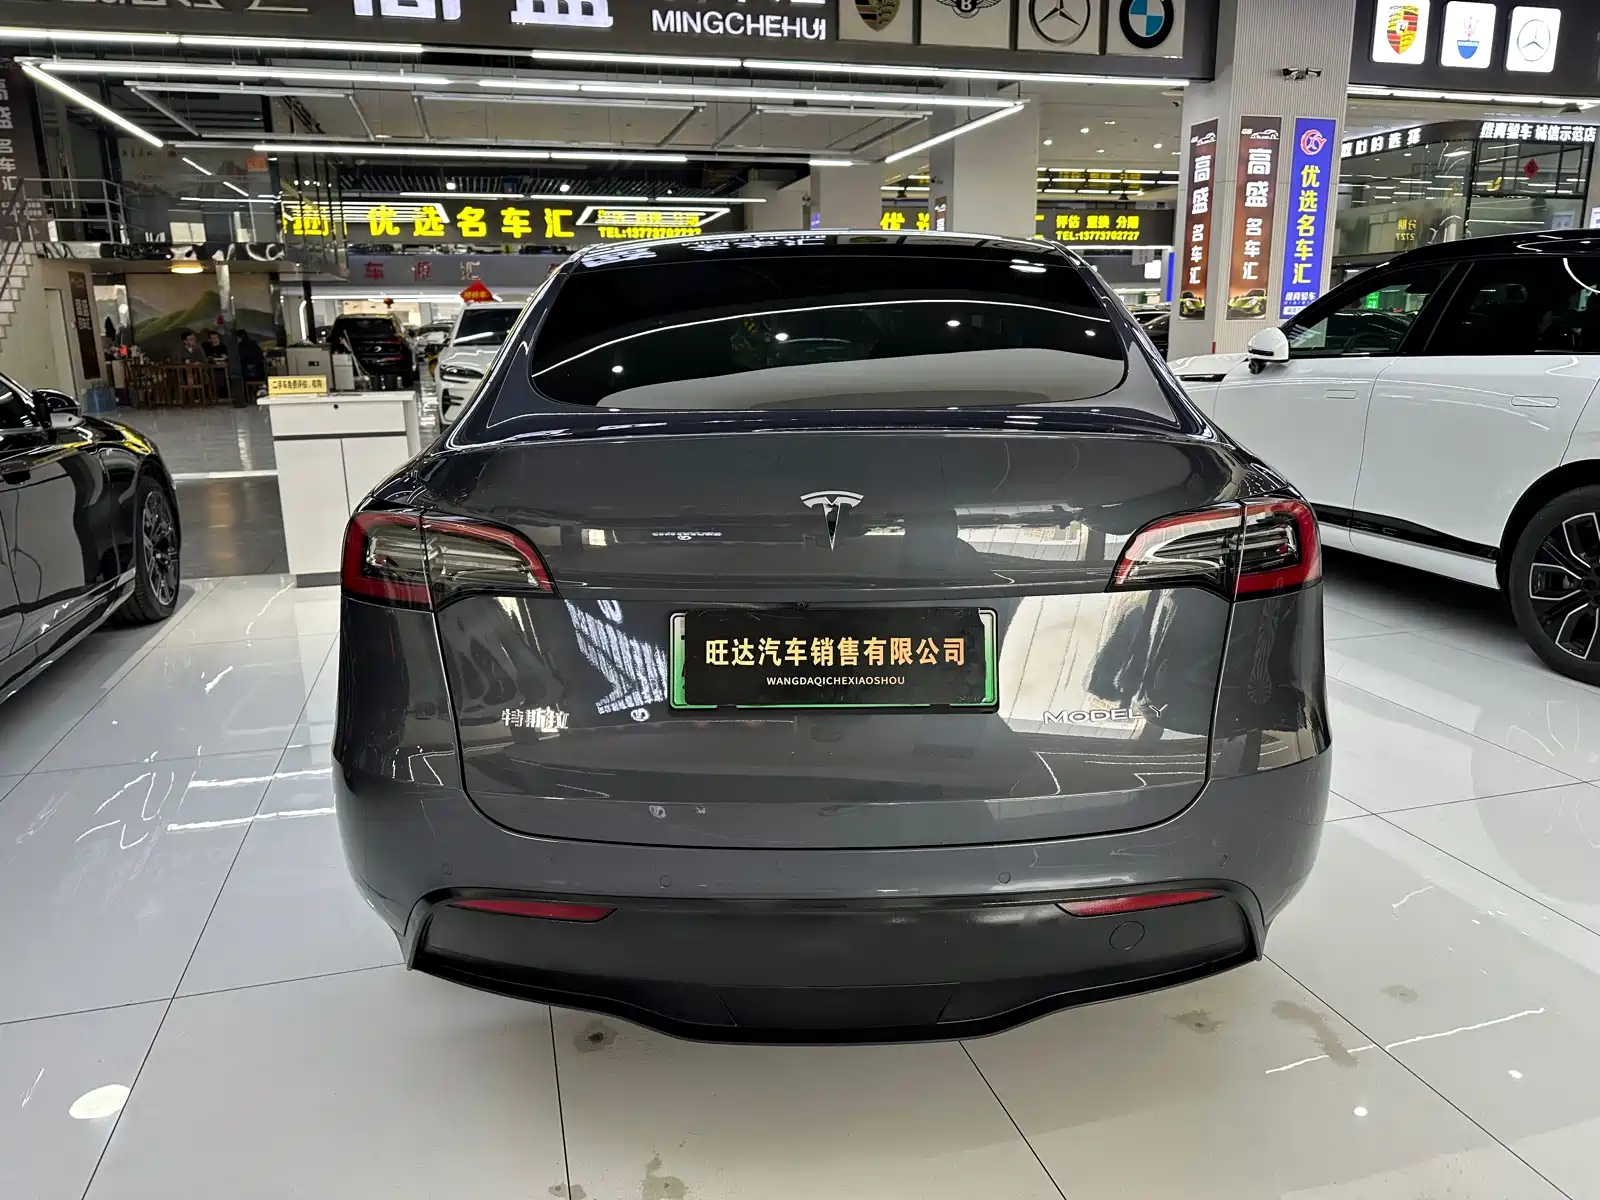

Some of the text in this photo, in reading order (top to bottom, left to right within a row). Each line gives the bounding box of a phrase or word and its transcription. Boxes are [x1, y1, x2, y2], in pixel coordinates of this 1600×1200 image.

[651, 9, 826, 40] MINGCHEHUI
[1292, 165, 1321, 285] 优选名车汇
[705, 637, 966, 667] 旺达汽车销售有限公司
[766, 676, 906, 687] WANGDAQICHEXIAOSHOU
[501, 706, 570, 732] 特斯拉
[1043, 703, 1169, 725] MODEL Y
